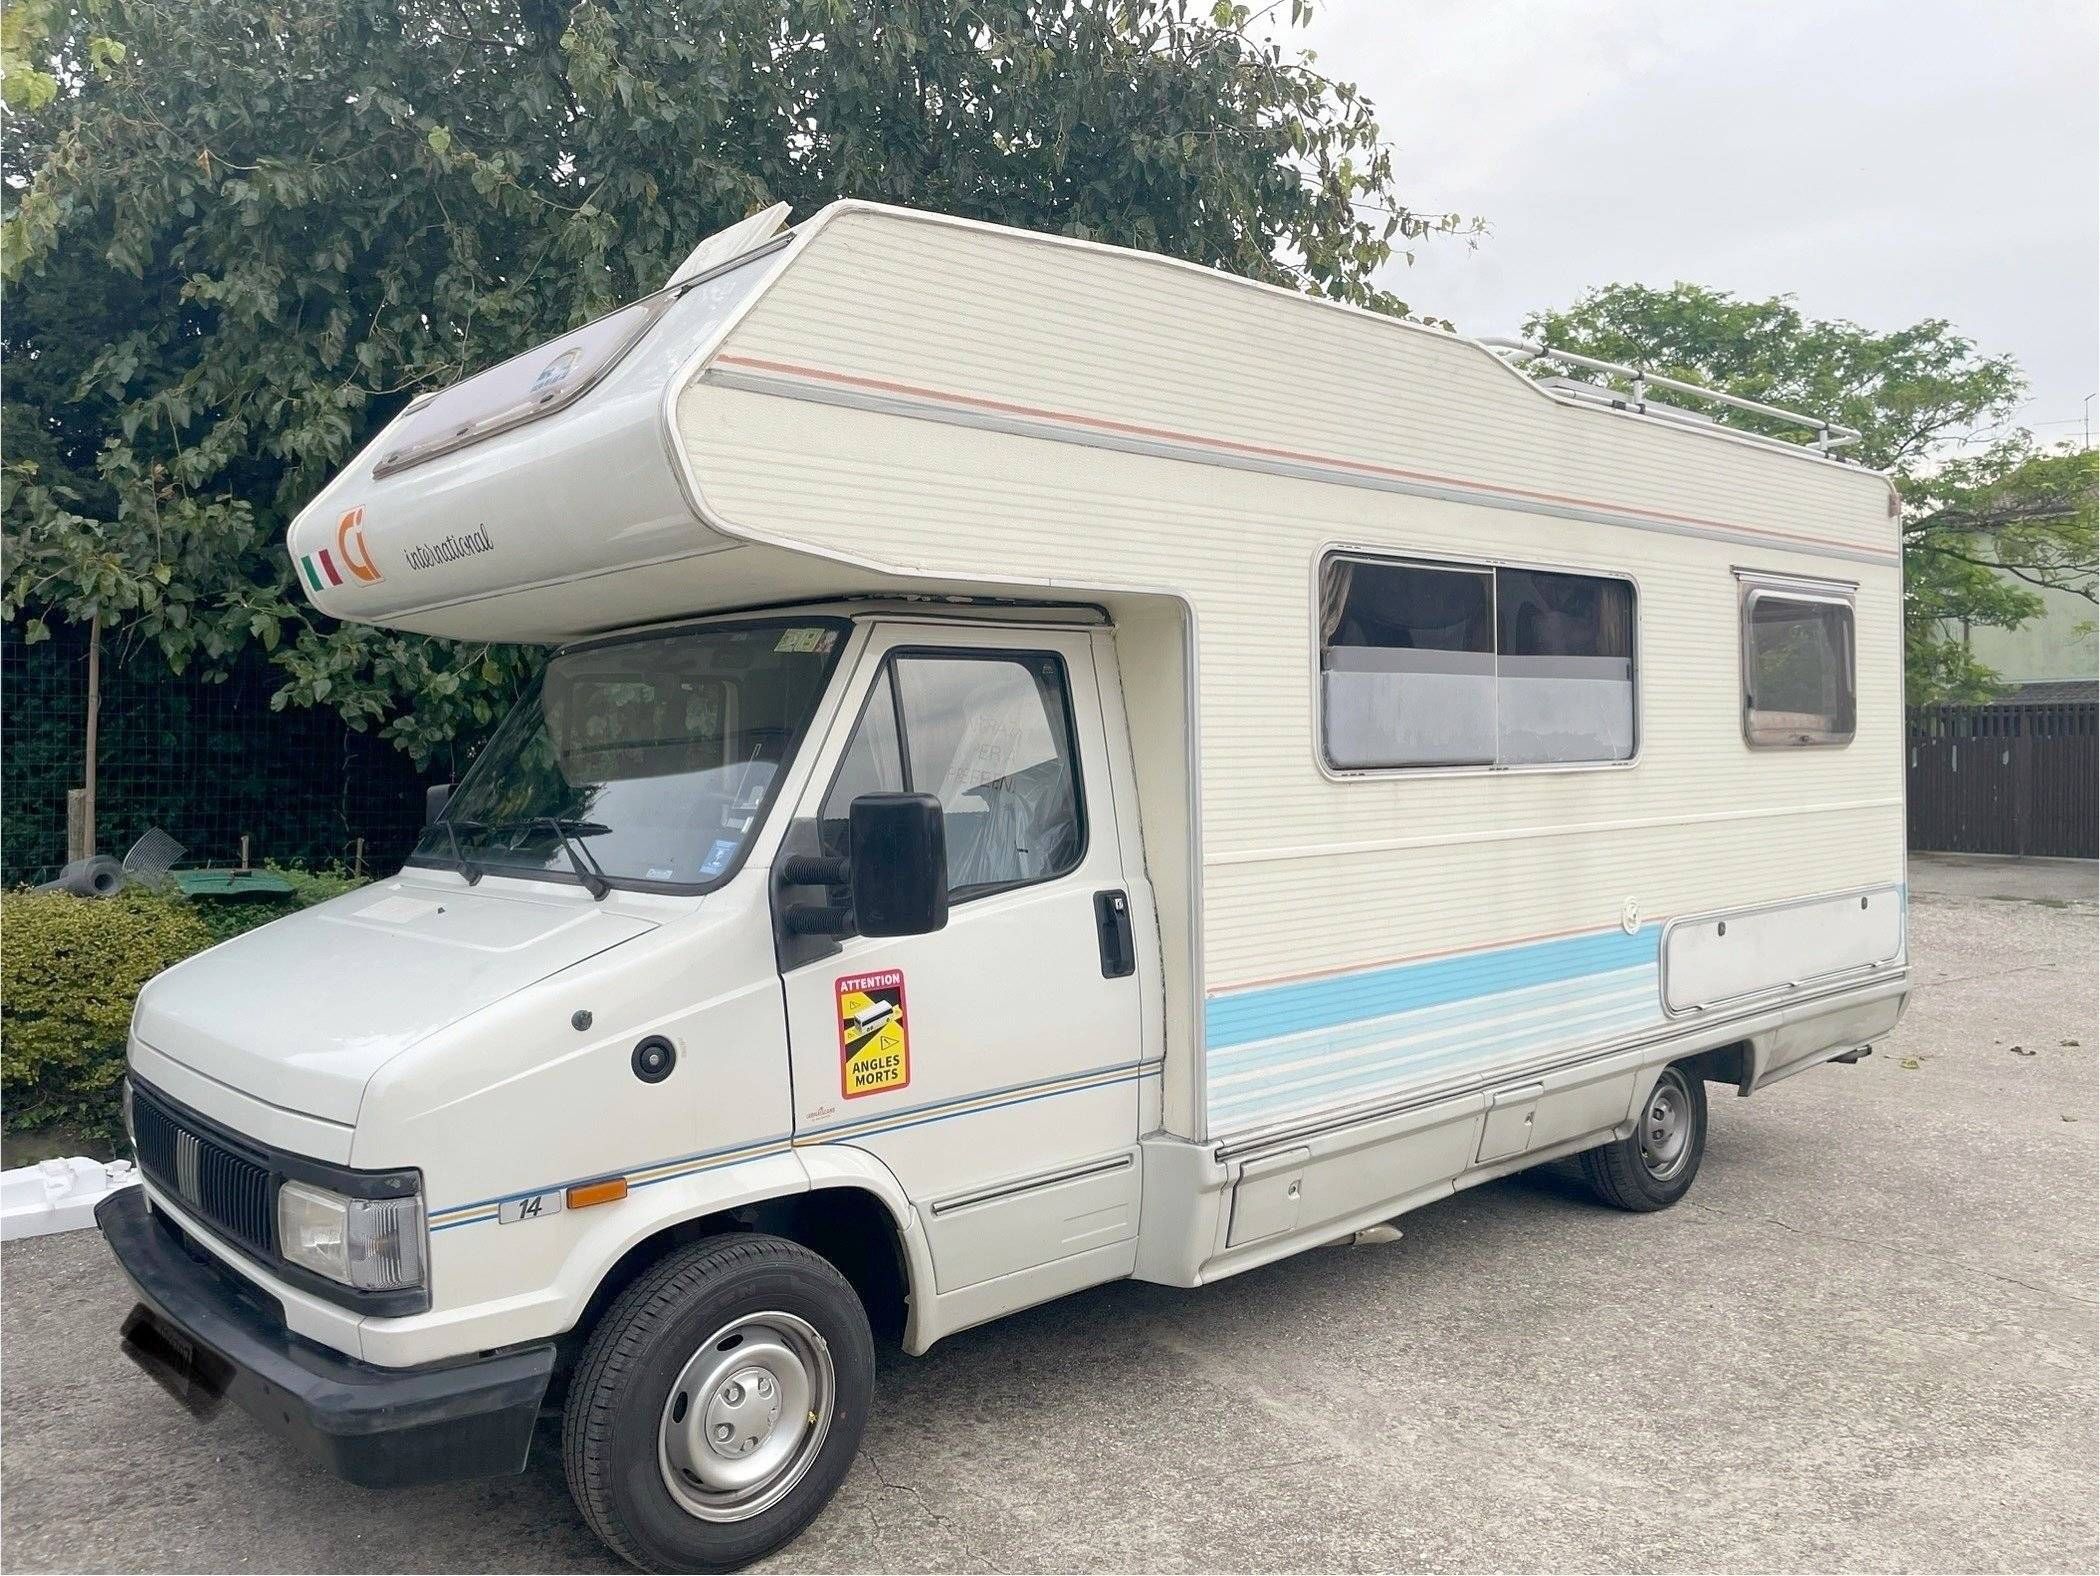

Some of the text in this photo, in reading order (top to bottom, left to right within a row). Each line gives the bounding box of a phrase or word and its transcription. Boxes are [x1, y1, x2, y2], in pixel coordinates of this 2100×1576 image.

[403, 522, 495, 571] international
[840, 973, 901, 993] ATTENTION
[852, 1054, 900, 1075] ANGLES
[855, 1068, 898, 1088] MORTS
[519, 1195, 542, 1219] 14
